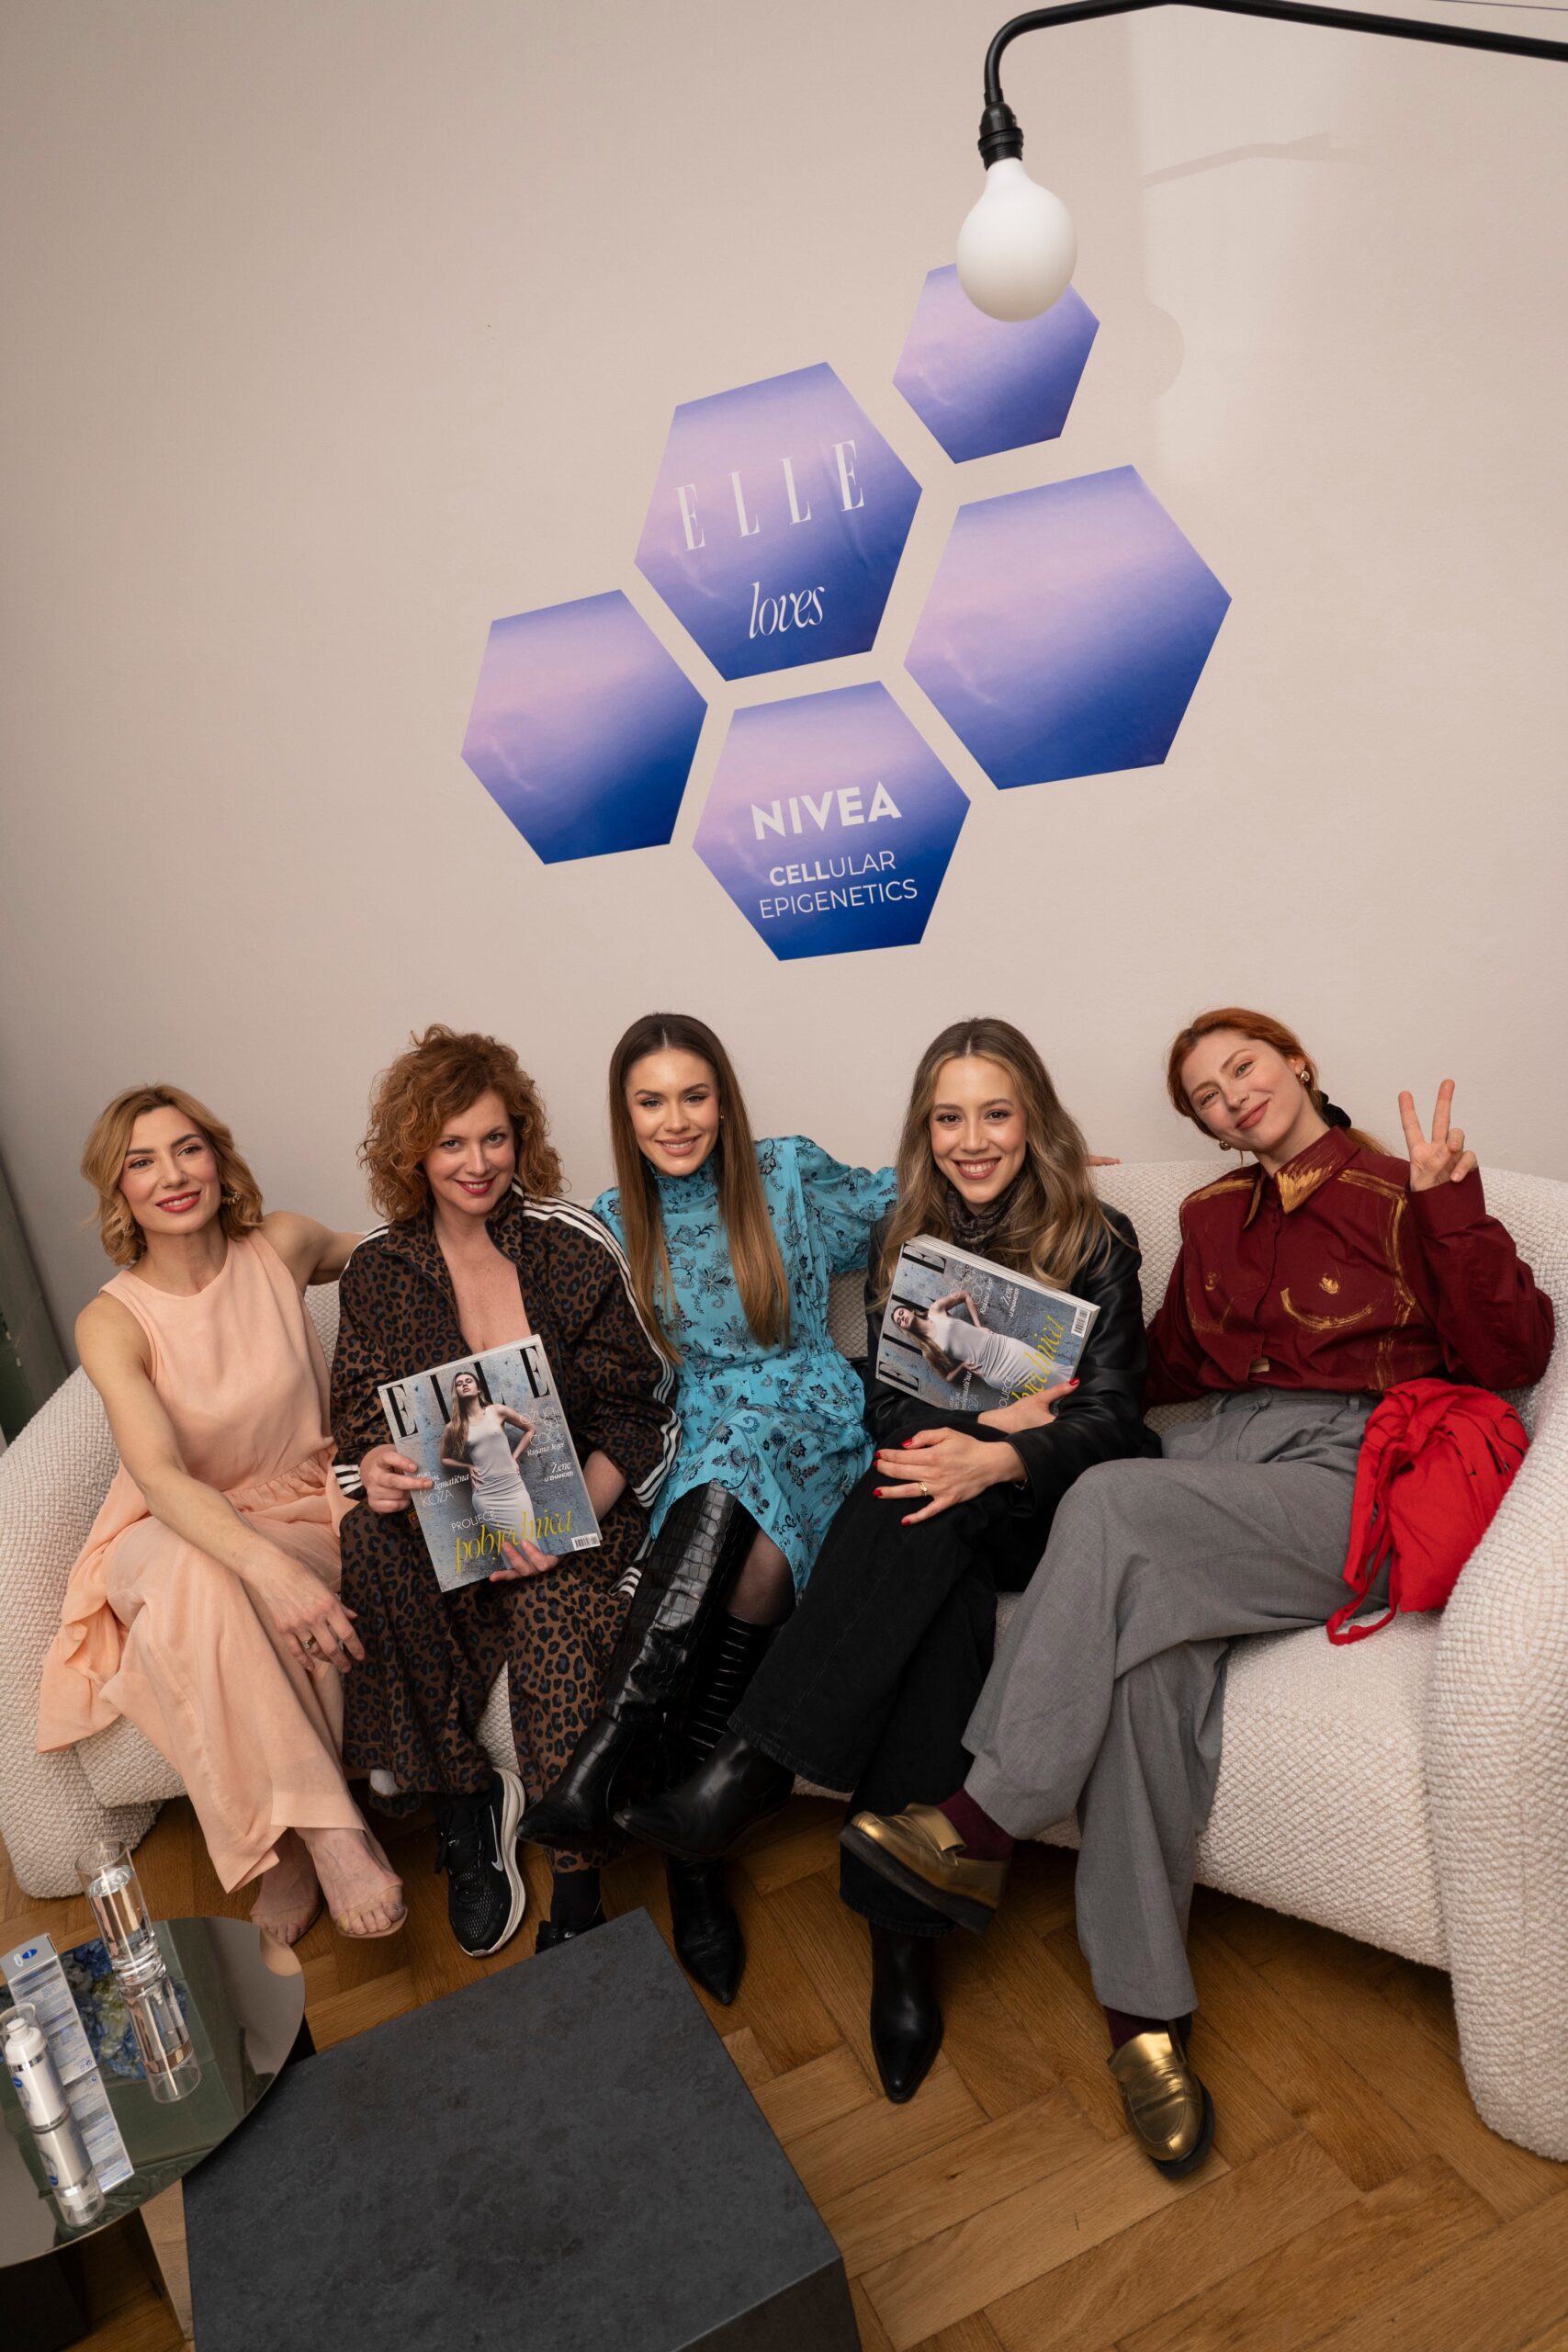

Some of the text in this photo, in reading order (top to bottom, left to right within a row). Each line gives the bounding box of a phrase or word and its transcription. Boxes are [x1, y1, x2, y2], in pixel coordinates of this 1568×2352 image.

[675, 439, 864, 551] ELLE
[749, 581, 825, 639] loves
[750, 781, 902, 841] NIVEA
[769, 851, 897, 887] CELLULAR
[759, 879, 918, 919] EPIGENETICS
[550, 1461, 571, 1474] Žene
